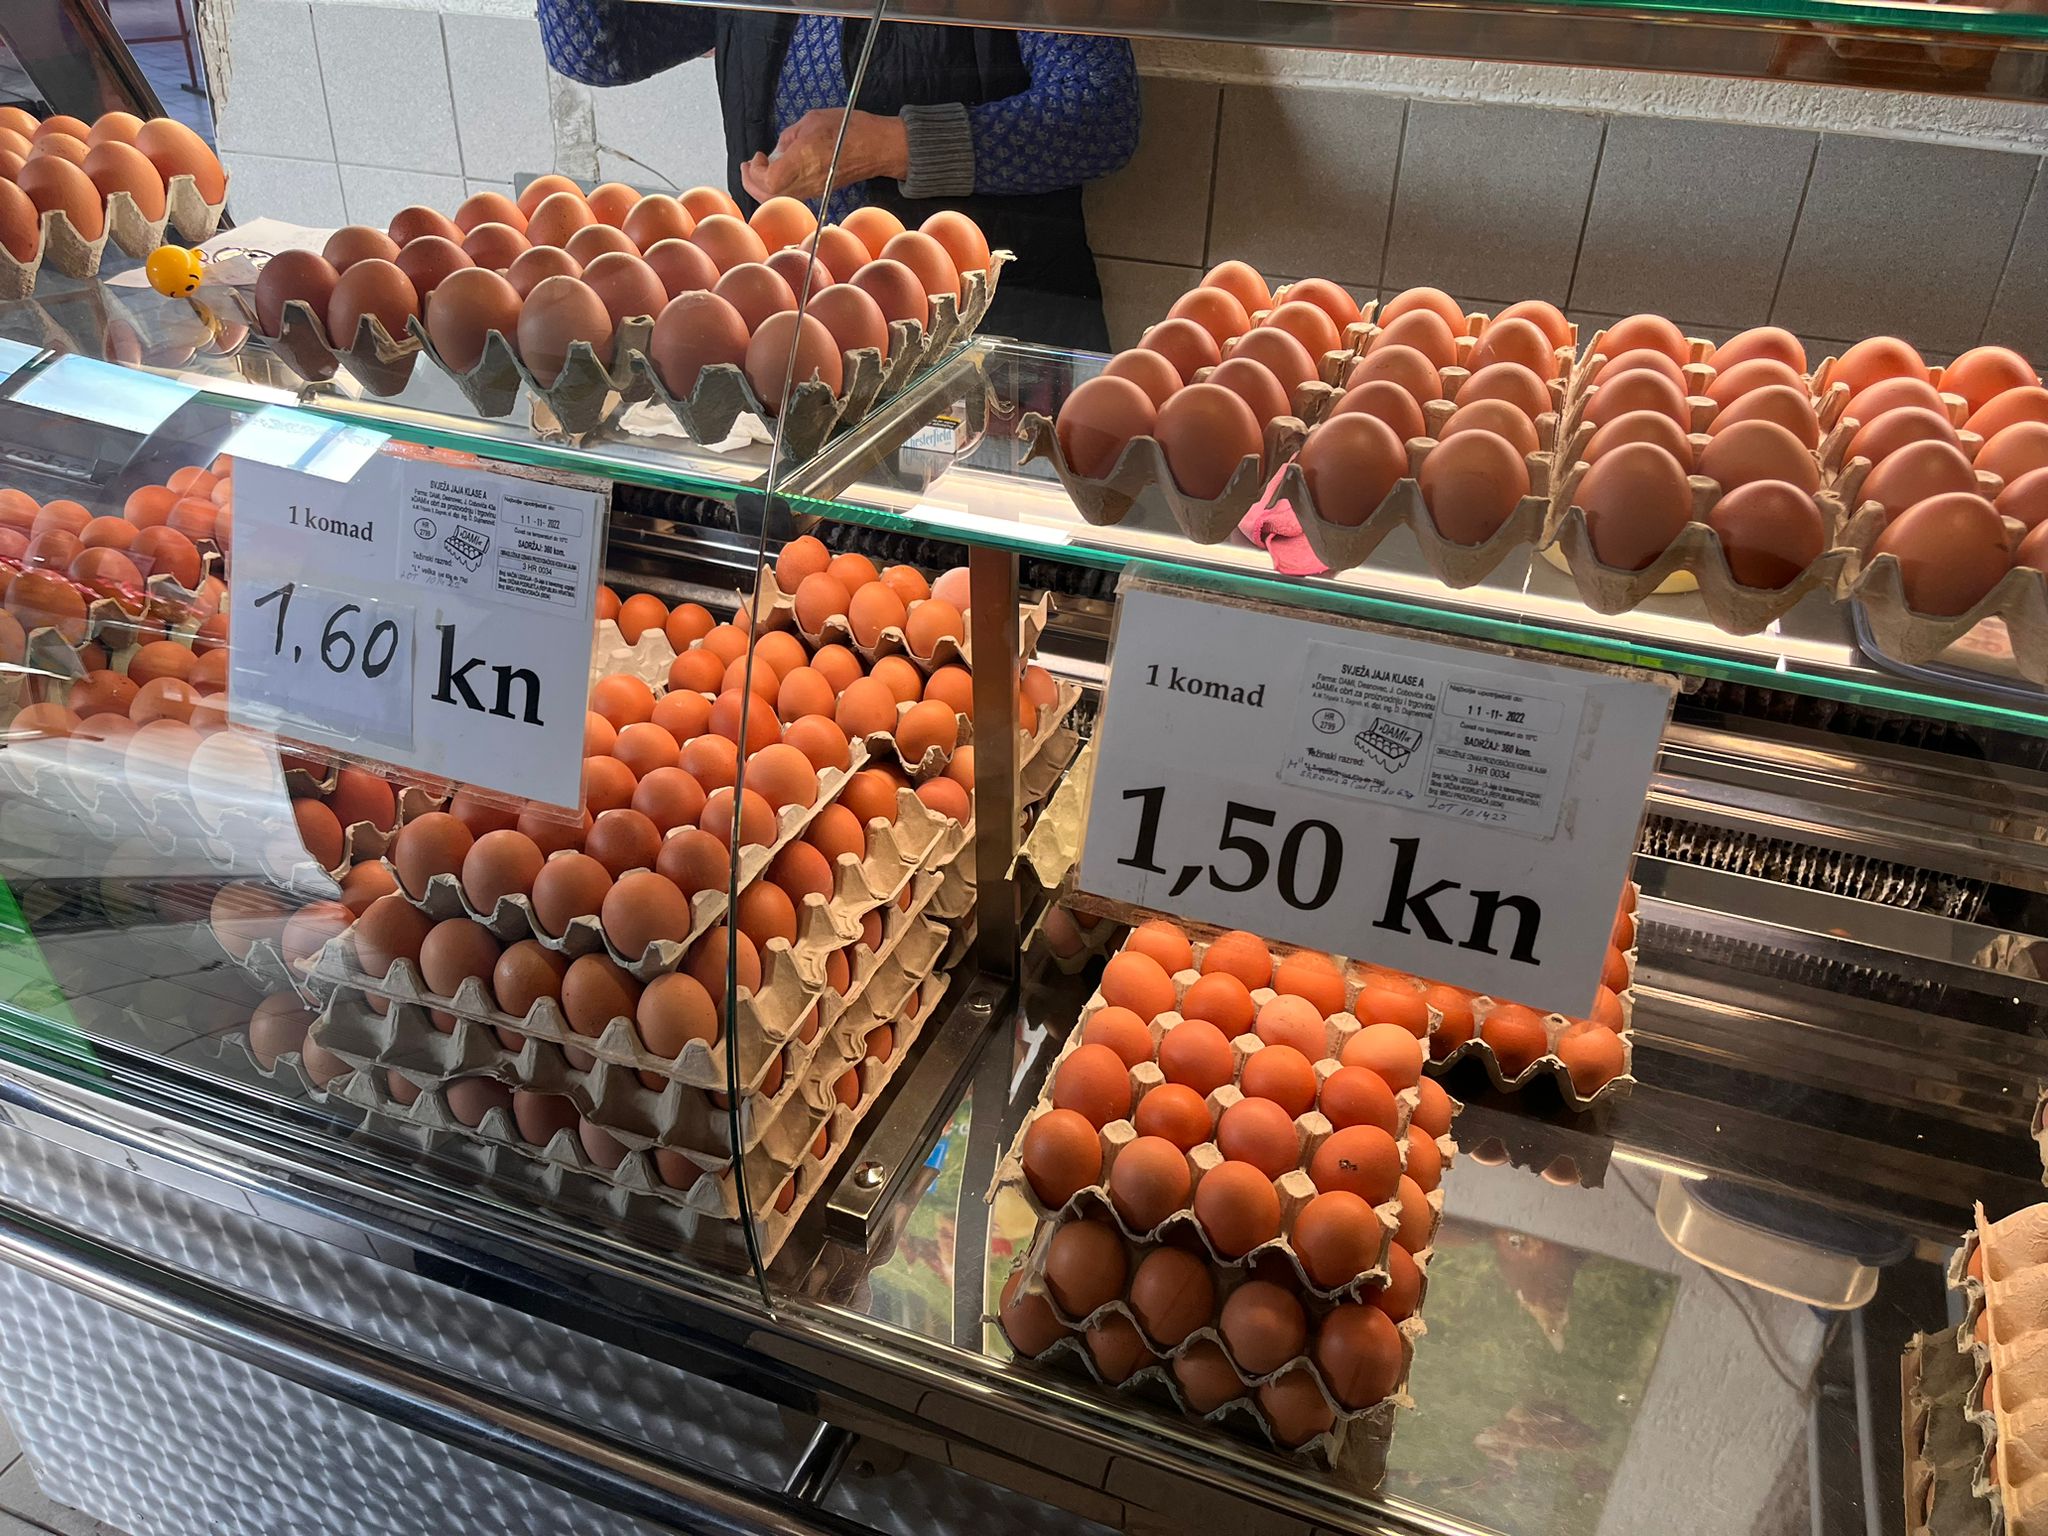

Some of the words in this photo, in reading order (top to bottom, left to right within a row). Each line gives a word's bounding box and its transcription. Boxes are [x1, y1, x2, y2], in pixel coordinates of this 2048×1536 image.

[430, 481, 449, 492] SVJEŽA
[464, 487, 482, 498] KLASE
[482, 491, 487, 499] A
[447, 504, 473, 515] proizvodnju
[477, 510, 496, 519] trgovinu
[289, 506, 298, 524] 1
[305, 508, 373, 542] komad
[528, 564, 537, 572] HR
[431, 624, 544, 727] kn
[1341, 664, 1370, 678] SVJEŽA
[1371, 669, 1390, 681] JAJA
[1392, 673, 1418, 687] KLASE
[1418, 678, 1424, 688] A
[1146, 664, 1159, 687] 1
[1168, 667, 1265, 708] komad
[1340, 686, 1353, 695] obrt
[1364, 691, 1403, 705] proizvodnju
[1408, 698, 1435, 711] trgovinu
[1324, 712, 1335, 721] HR
[1506, 711, 1525, 724] 2022
[1320, 721, 1336, 730] 2799
[1464, 736, 1500, 751] SADRŽAJ:
[1338, 755, 1364, 766] razred:
[1467, 764, 1473, 772] 3
[1474, 765, 1488, 776] HR
[1490, 768, 1510, 779] 0034
[1428, 798, 1457, 812] LOT
[1117, 785, 1344, 912] 1,50
[1372, 837, 1542, 966] kn
